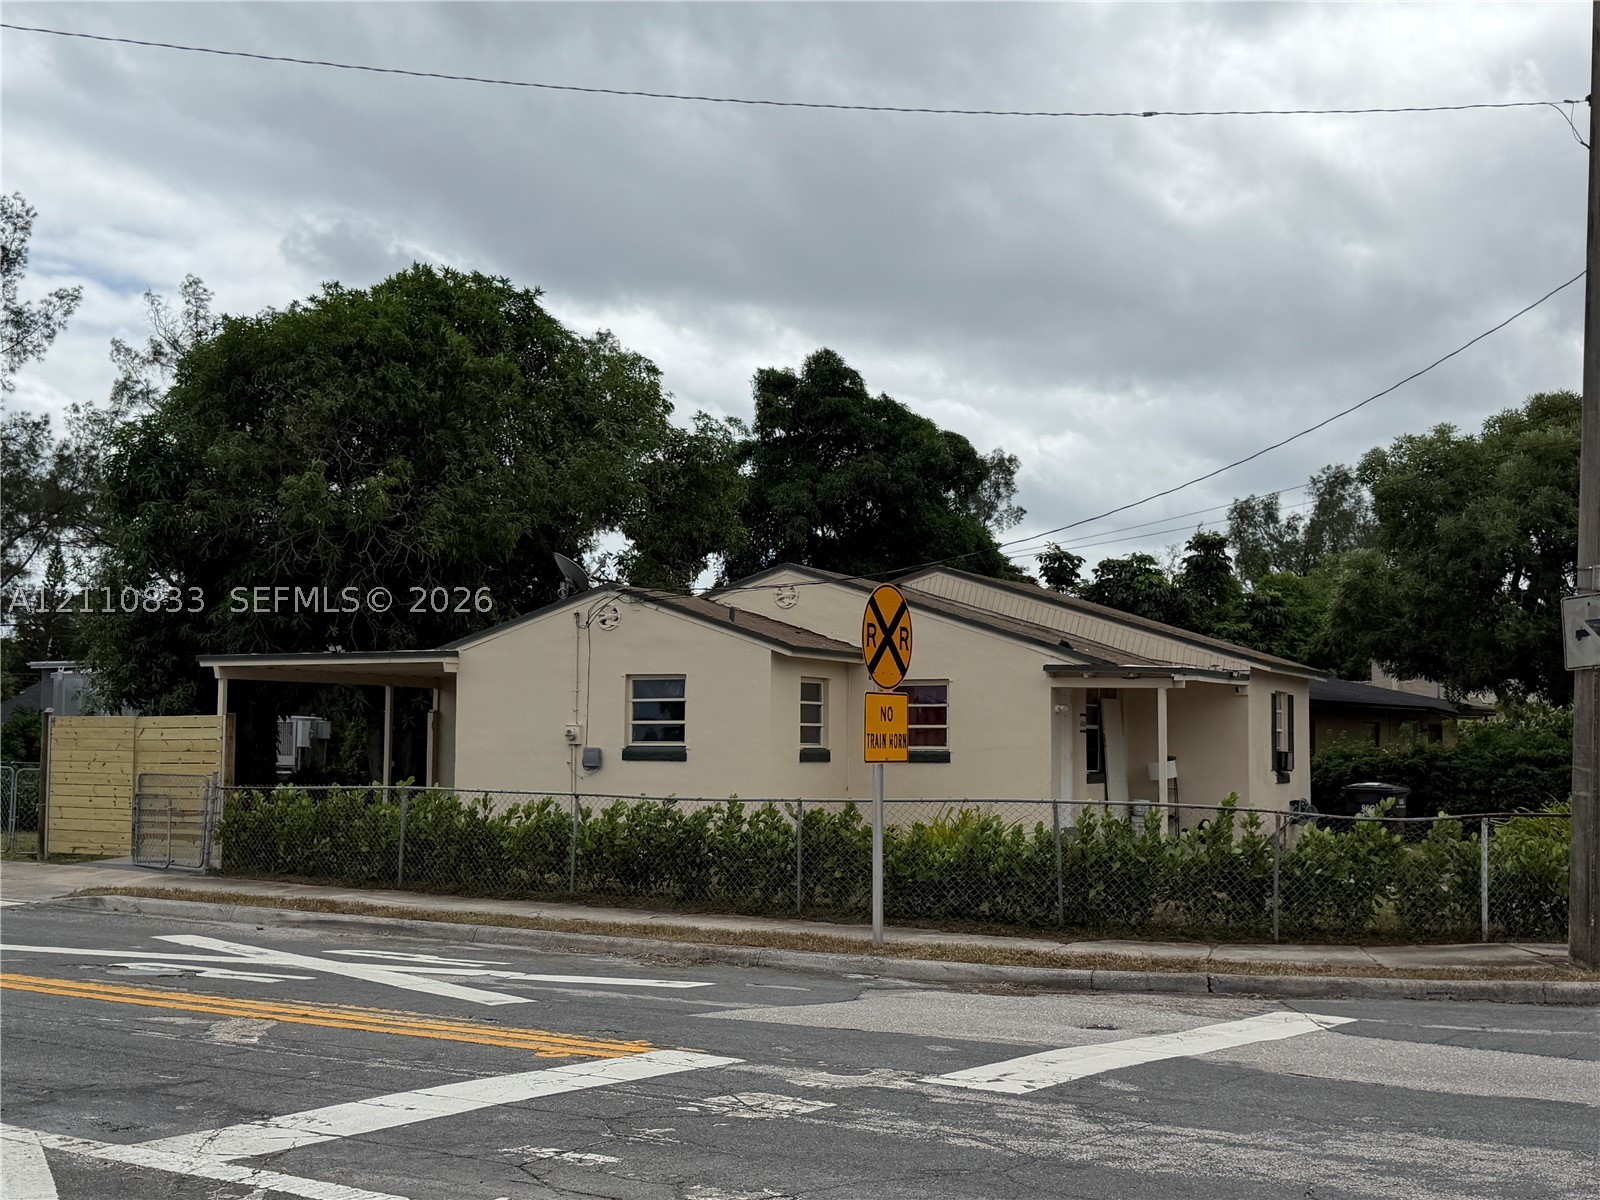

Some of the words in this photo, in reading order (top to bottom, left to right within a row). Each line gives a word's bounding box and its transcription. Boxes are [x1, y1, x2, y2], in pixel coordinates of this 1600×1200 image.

[880, 705, 894, 722] NO
[866, 733, 887, 749] TRAIN
[889, 733, 907, 749] HORN
